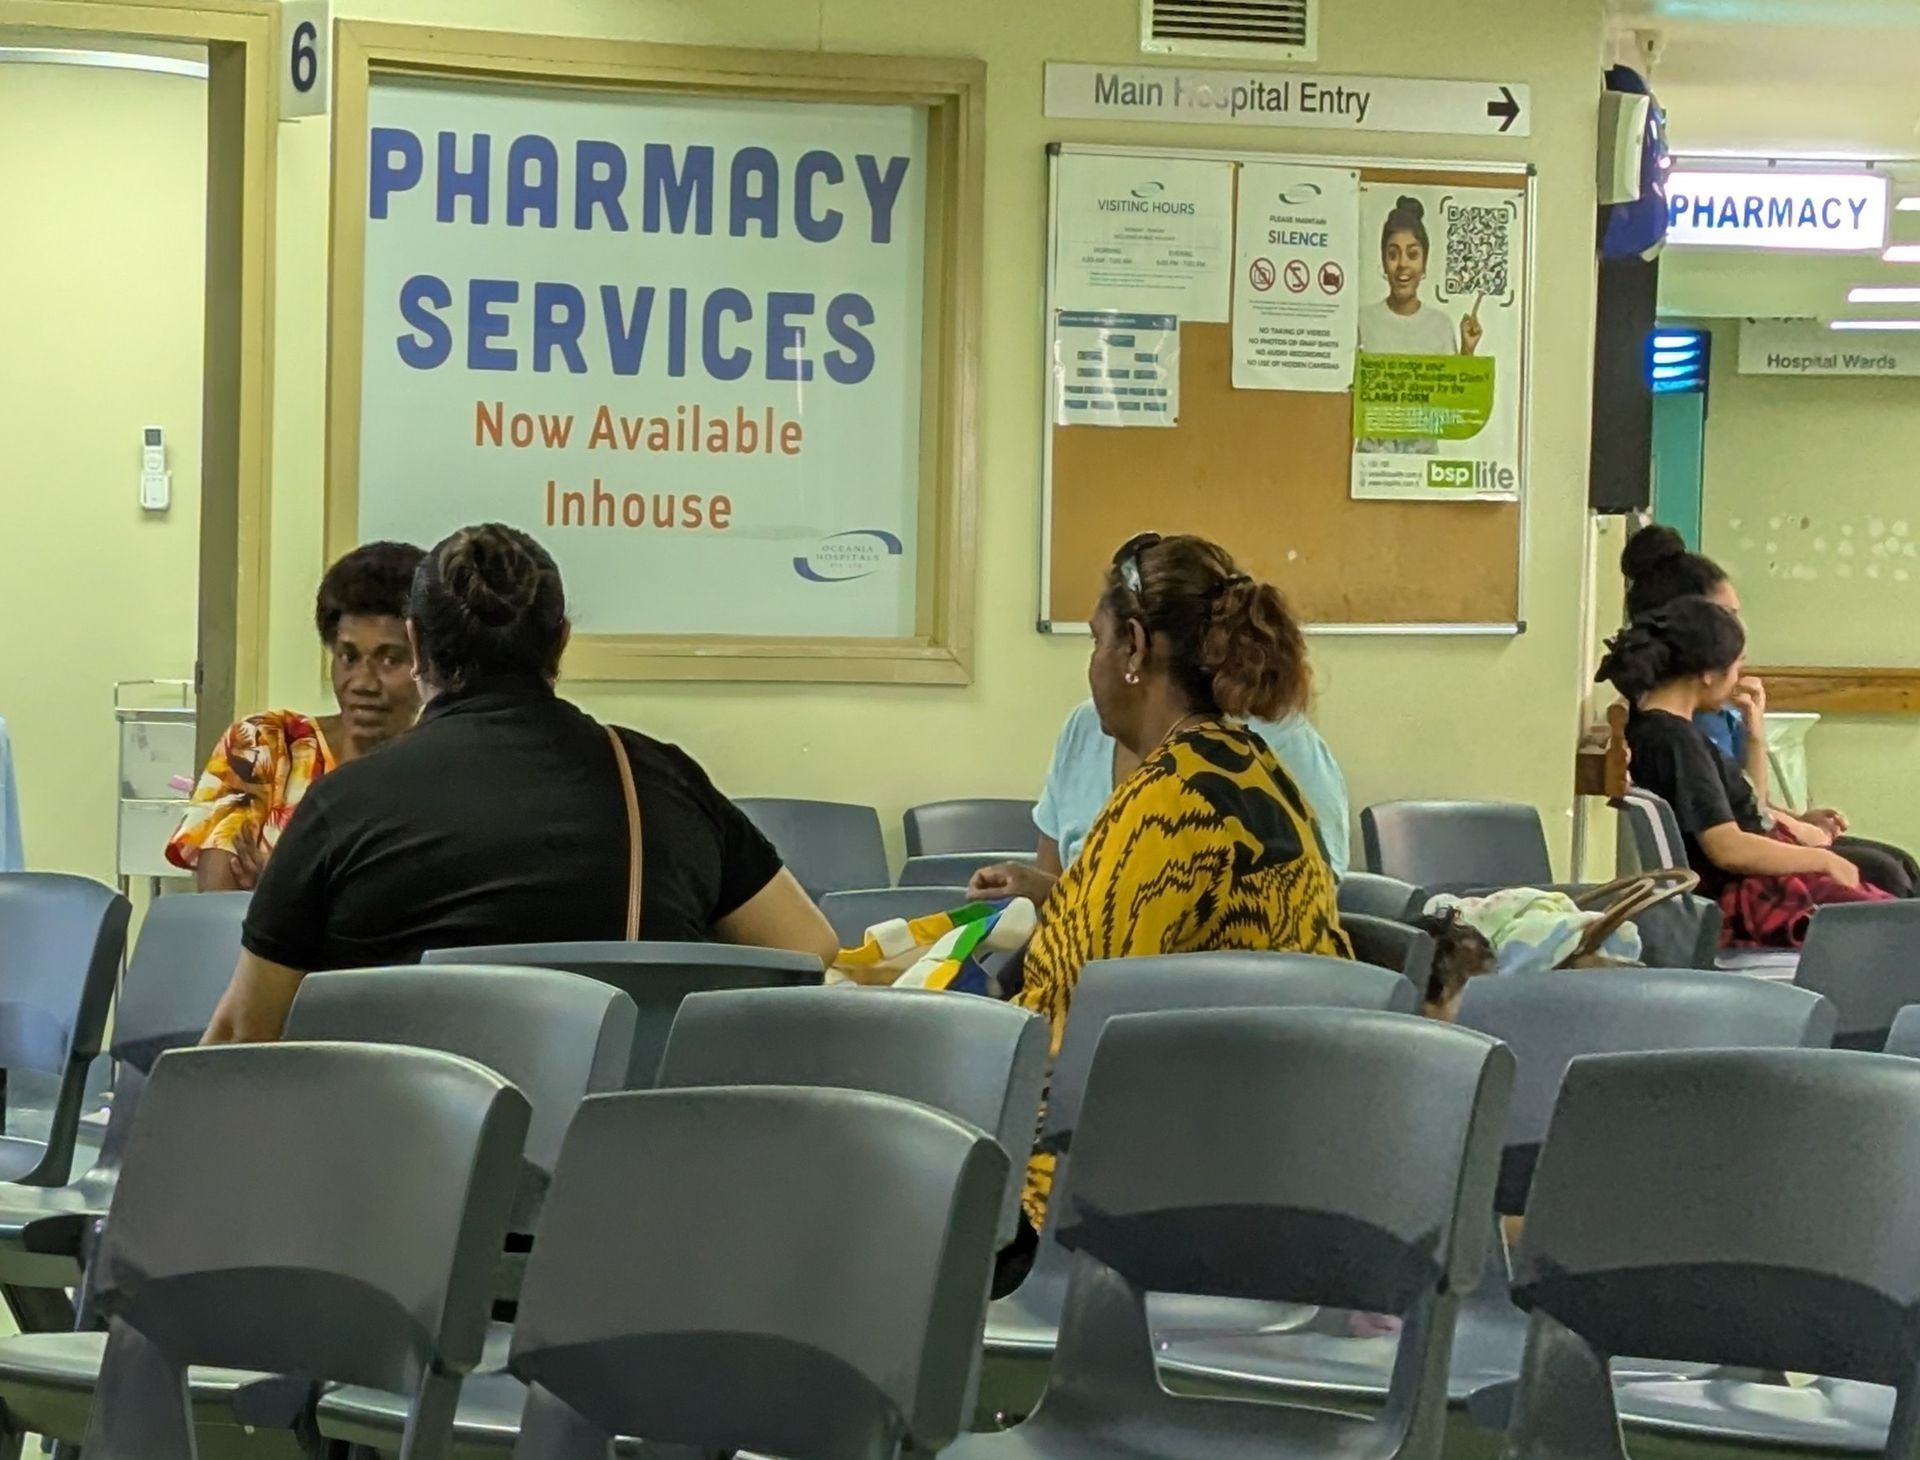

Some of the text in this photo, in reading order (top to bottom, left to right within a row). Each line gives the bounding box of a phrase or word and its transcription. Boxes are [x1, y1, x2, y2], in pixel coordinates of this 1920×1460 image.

[289, 21, 317, 92] 6
[1094, 72, 1163, 106] Main
[1299, 81, 1371, 124] Entry
[368, 126, 911, 245] PHARMACY
[1097, 199, 1196, 215] VISITING HOURS
[1668, 193, 1868, 231] PHARMACY
[1268, 229, 1328, 248] SILENCE
[396, 274, 876, 386] SERVICES
[1270, 327, 1295, 335] TAKING
[1296, 328, 1305, 336] OF
[1766, 353, 1896, 372] Hospital Wards
[474, 400, 803, 456] Now Available
[1431, 460, 1515, 489] bsp life
[546, 478, 732, 529] Inhouse
[816, 553, 880, 561] HOSPITALS
[821, 544, 875, 553] OCEANIA
